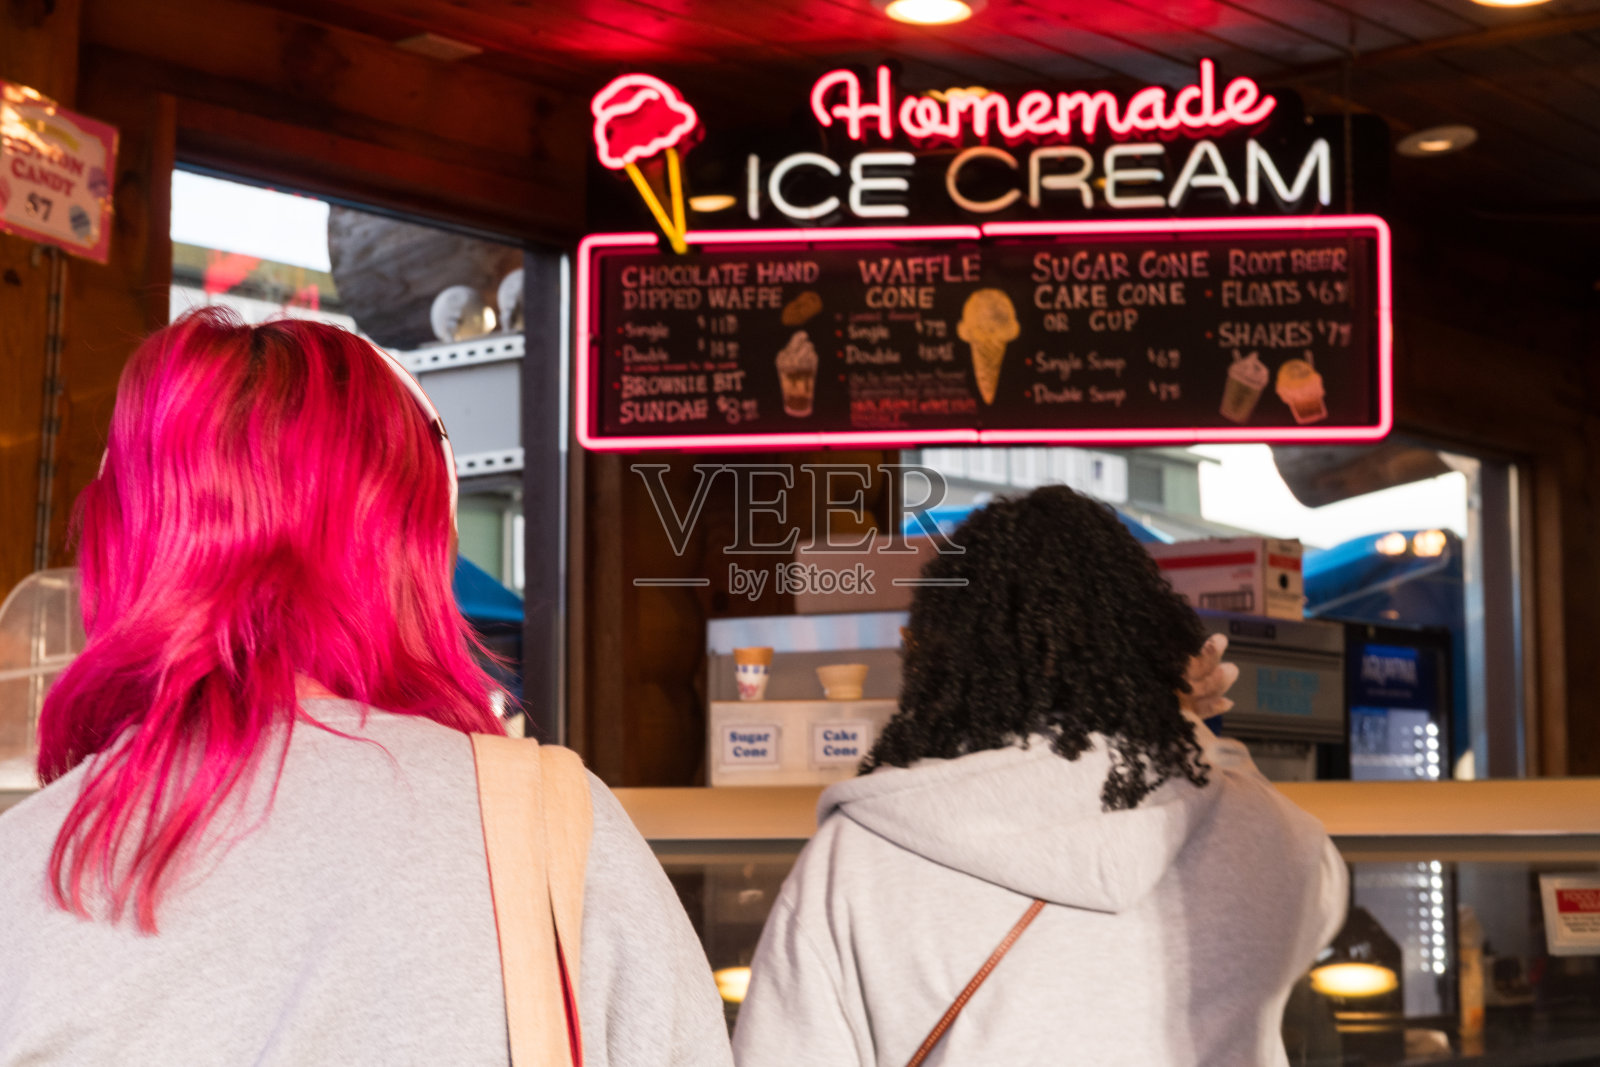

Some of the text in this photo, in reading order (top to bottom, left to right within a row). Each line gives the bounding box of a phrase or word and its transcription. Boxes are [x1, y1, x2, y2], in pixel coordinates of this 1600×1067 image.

[809, 56, 1277, 143] Homemade
[11, 157, 76, 197] CANDY
[746, 139, 1332, 220] ICE CREAM
[621, 261, 819, 288] CHOCOLATE HAND
[858, 253, 981, 284] WAFFLE
[1032, 250, 1210, 282] SUGAR CONE
[1228, 247, 1347, 277] ROOT BEER
[622, 287, 702, 310] DIPPED
[866, 286, 935, 309] CONE
[1034, 281, 1186, 310] CAKE CONE
[1221, 280, 1302, 308] FLOATS
[1089, 308, 1139, 332] CUP
[1218, 321, 1313, 348] SHAKES
[620, 374, 708, 399] BROWNIE
[619, 398, 709, 425] SUNDAE
[730, 731, 770, 745] Sugar
[822, 730, 858, 742] Cake
[732, 745, 768, 758] Cone
[823, 744, 859, 757] Cone
